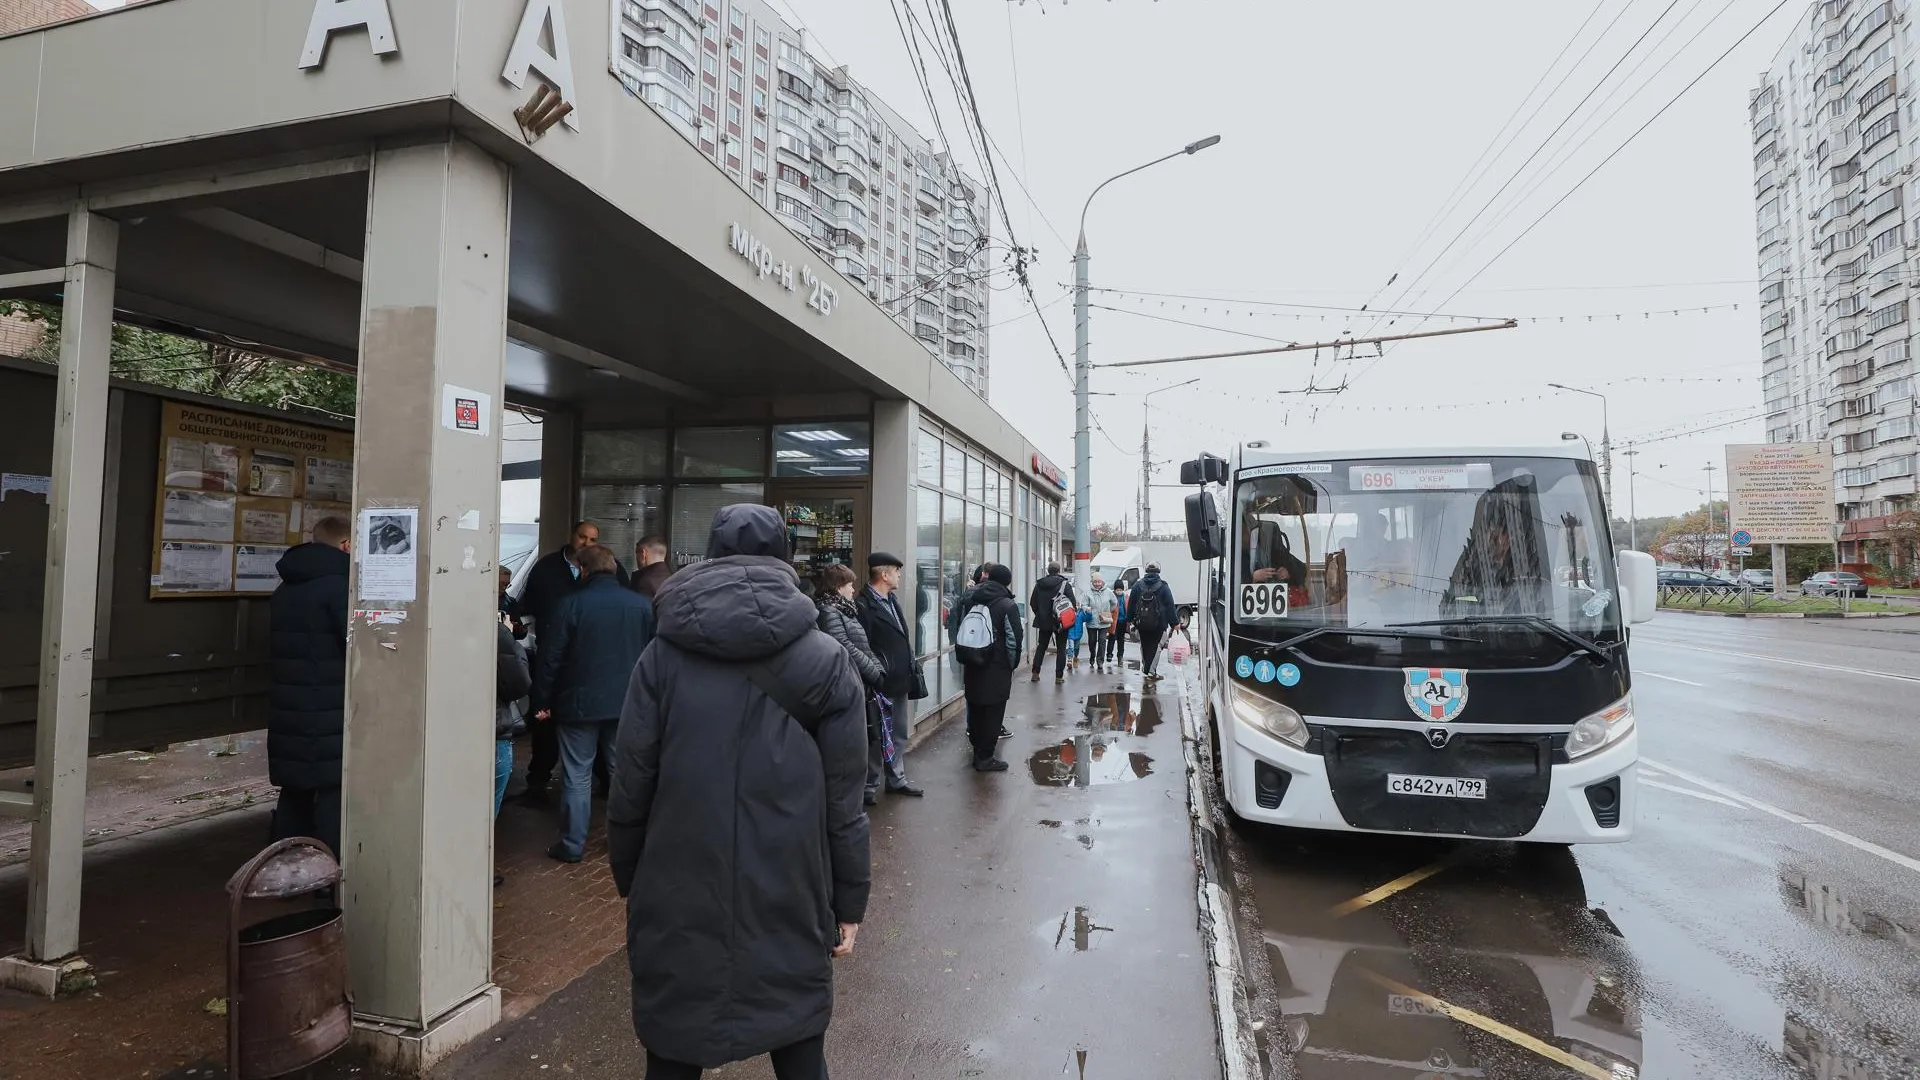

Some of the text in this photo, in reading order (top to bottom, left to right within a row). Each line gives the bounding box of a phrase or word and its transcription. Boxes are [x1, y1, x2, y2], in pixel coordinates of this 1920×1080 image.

[179, 423, 327, 453] ОБЩЕСТВЕННОГО ТРАНСПОРТА
[181, 410, 328, 443] РАСПИСАНИЕ ДВИЖЕНИЯ
[1363, 472, 1393, 488] 696
[1241, 584, 1287, 615] 696
[1457, 780, 1482, 792] 799
